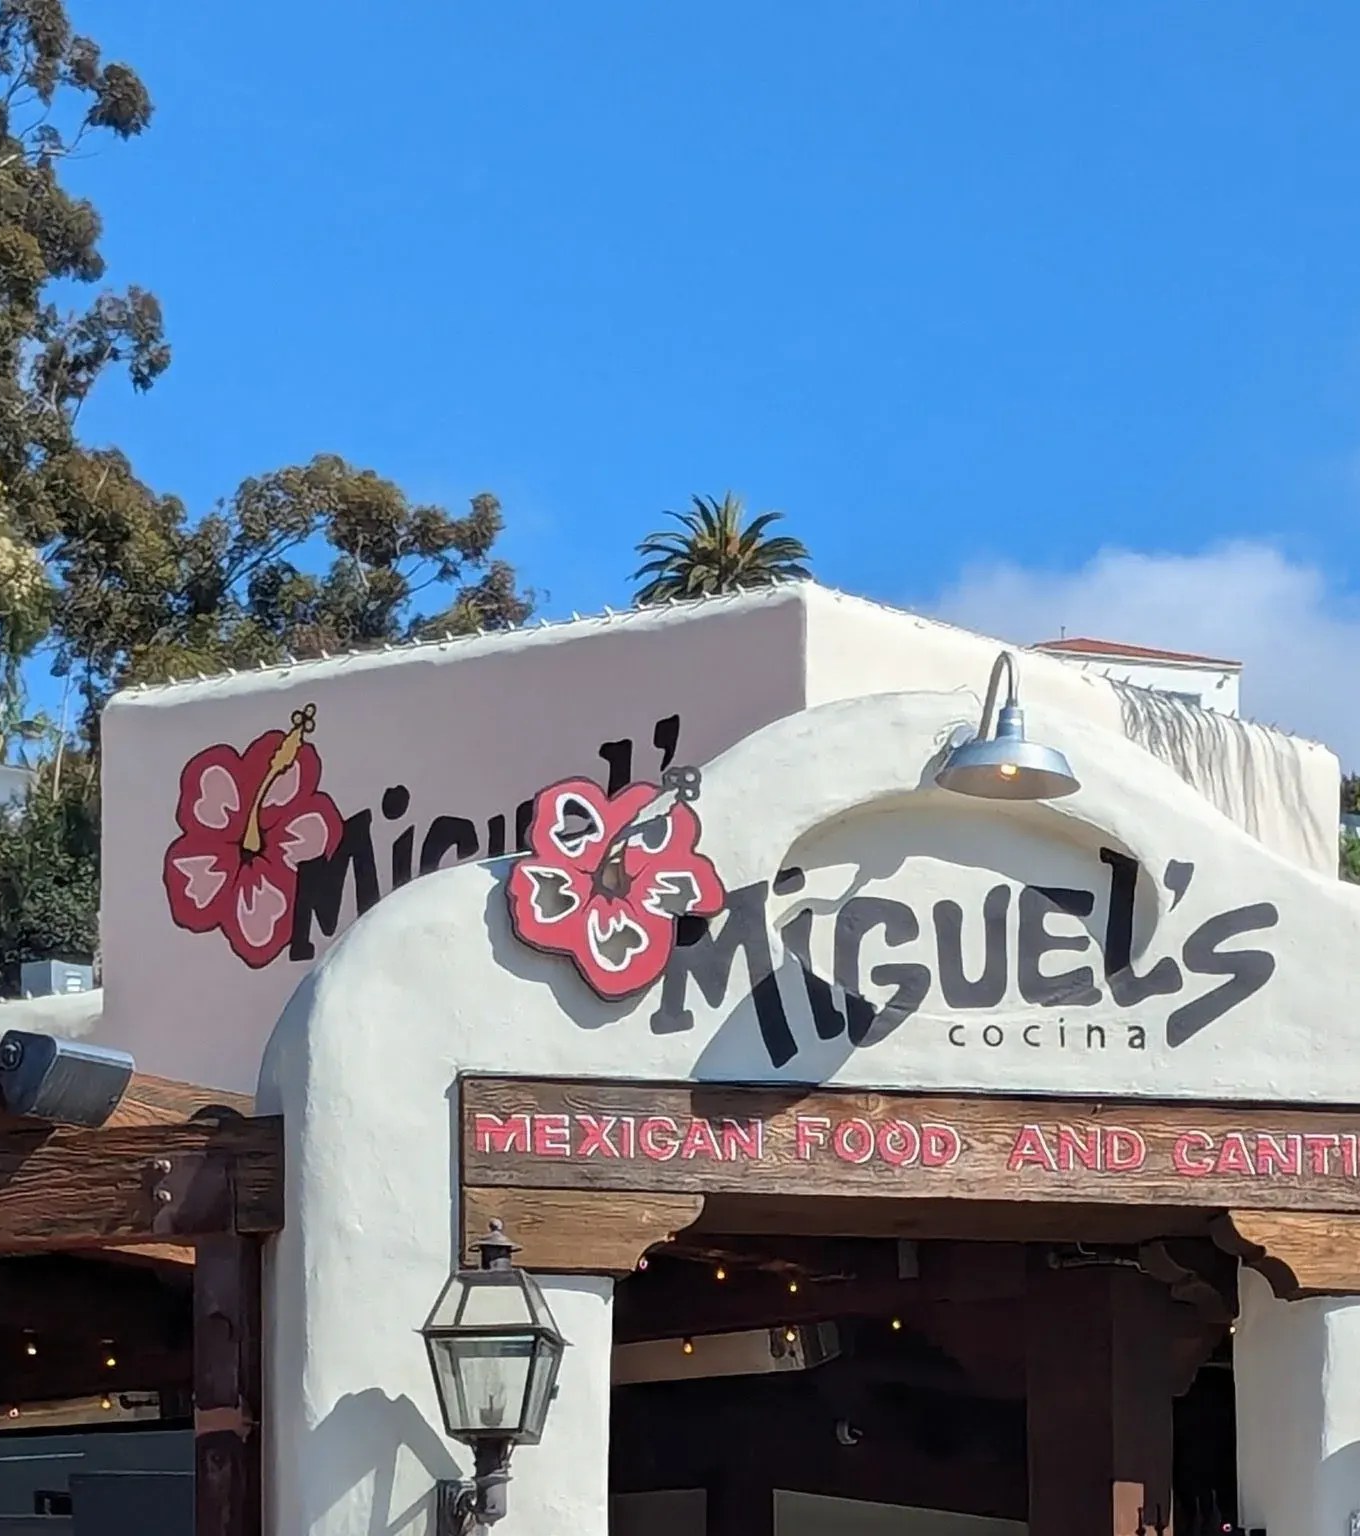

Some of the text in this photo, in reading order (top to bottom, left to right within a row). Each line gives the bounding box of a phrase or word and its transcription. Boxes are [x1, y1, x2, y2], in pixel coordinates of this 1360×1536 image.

[948, 1018, 1146, 1049] cocina
[474, 1114, 763, 1161] MEXICAN
[795, 1116, 961, 1166] FOOD
[1008, 1124, 1145, 1173] AND
